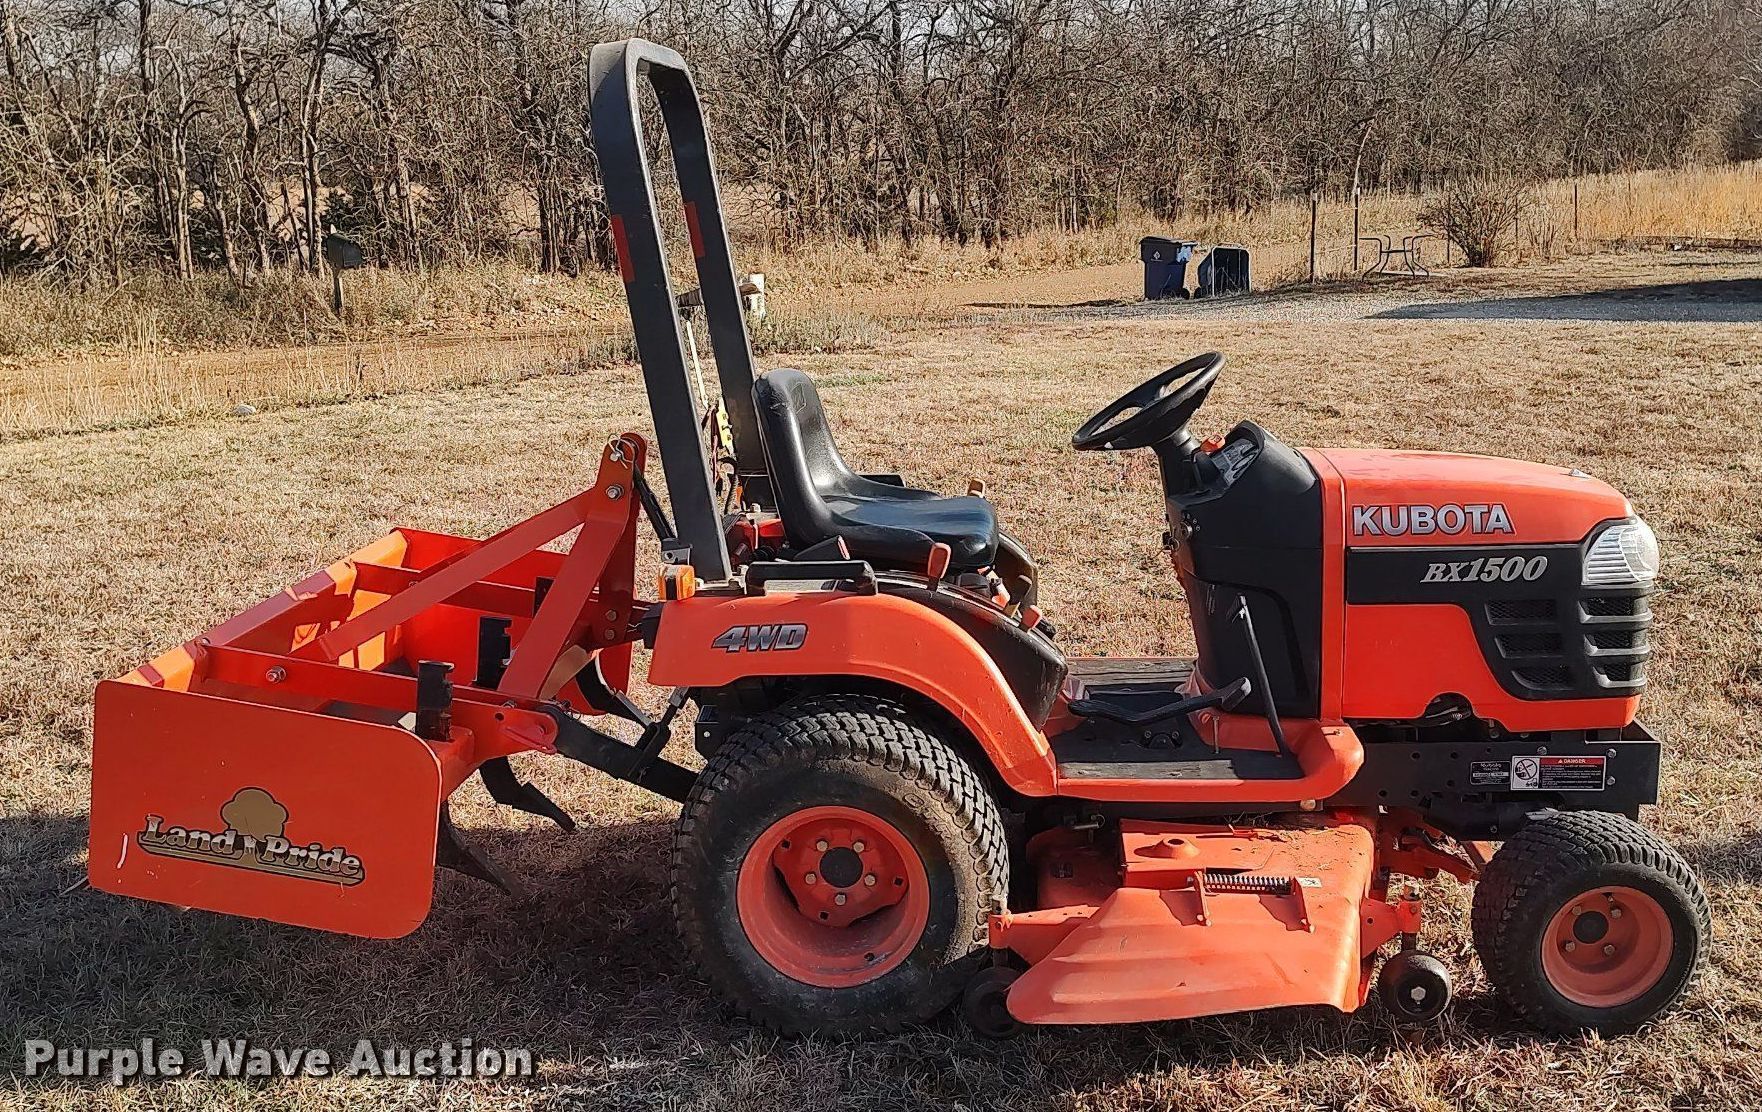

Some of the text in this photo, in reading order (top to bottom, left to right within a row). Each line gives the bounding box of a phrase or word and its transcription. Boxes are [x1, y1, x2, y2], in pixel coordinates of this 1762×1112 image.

[1352, 503, 1515, 536] KUBOTA
[1420, 555, 1549, 583] BX1500
[711, 623, 808, 653] 4WD
[142, 815, 362, 876] Land Pride
